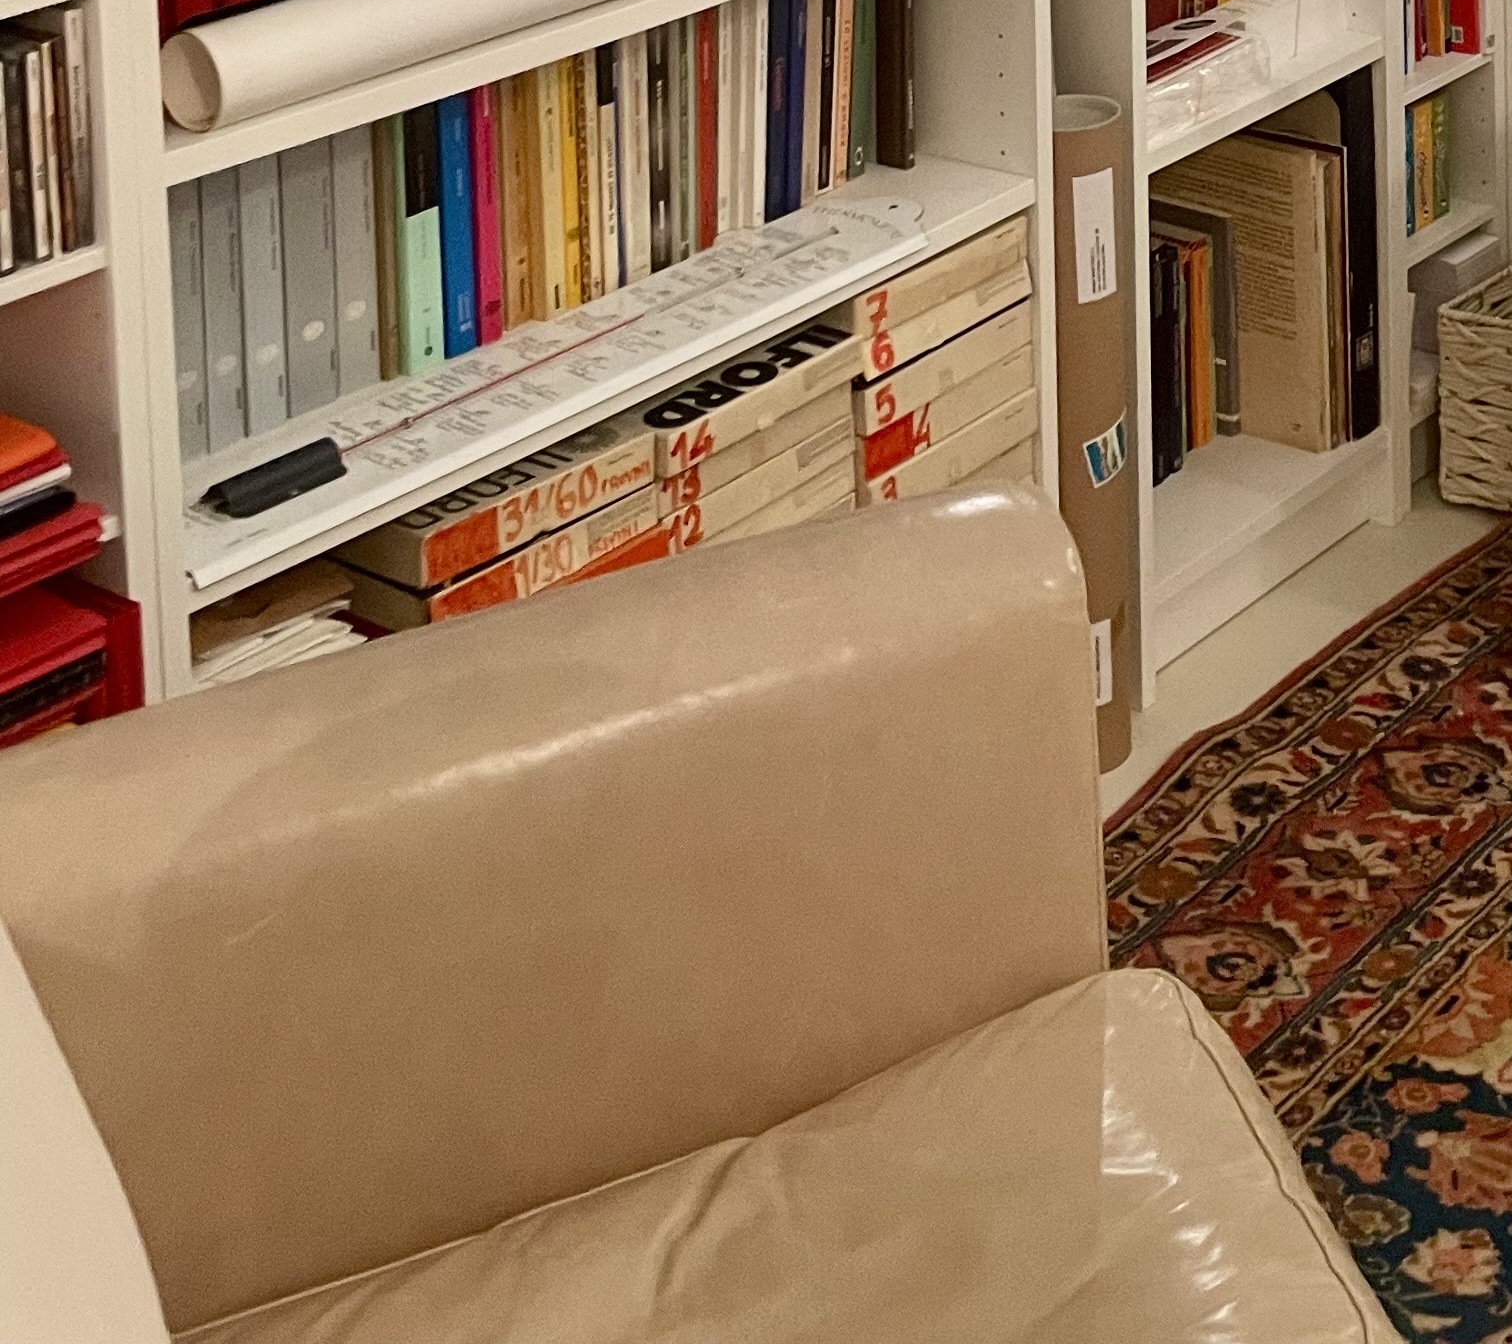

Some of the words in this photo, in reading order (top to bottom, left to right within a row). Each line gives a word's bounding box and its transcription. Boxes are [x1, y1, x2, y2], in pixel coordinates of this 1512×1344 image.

[643, 324, 852, 429] ILFORD
[869, 332, 895, 373] 6
[875, 383, 898, 425] 5
[400, 448, 574, 530] ILFORD
